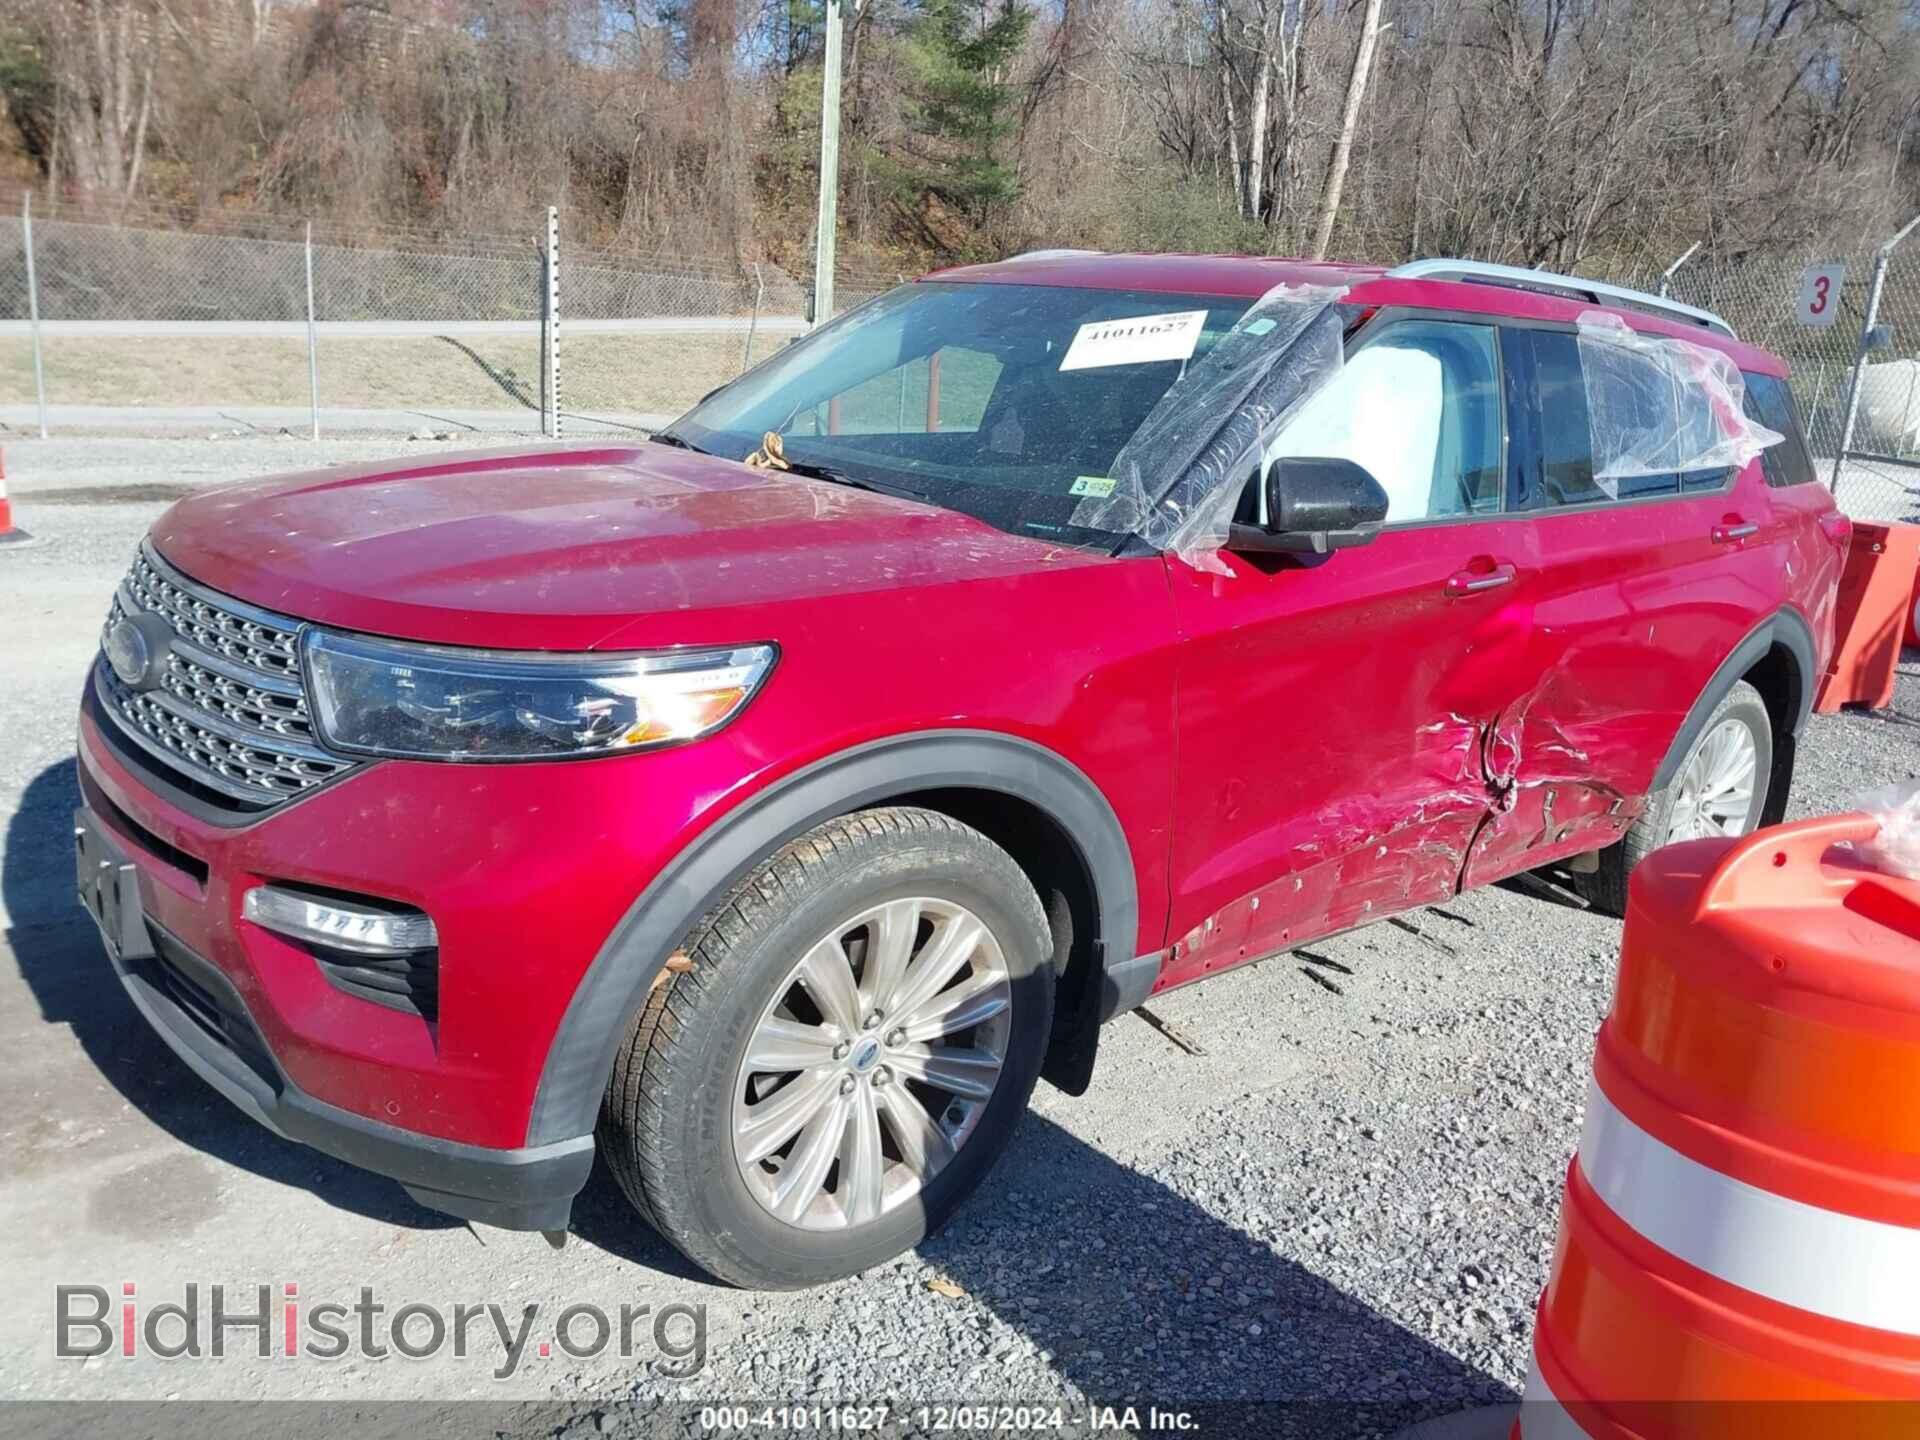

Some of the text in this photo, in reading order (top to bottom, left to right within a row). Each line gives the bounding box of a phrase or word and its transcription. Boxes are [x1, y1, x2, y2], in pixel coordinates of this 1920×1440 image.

[1810, 276, 1830, 314] 3
[1088, 321, 1188, 340] 41011627
[1076, 480, 1088, 491] 3
